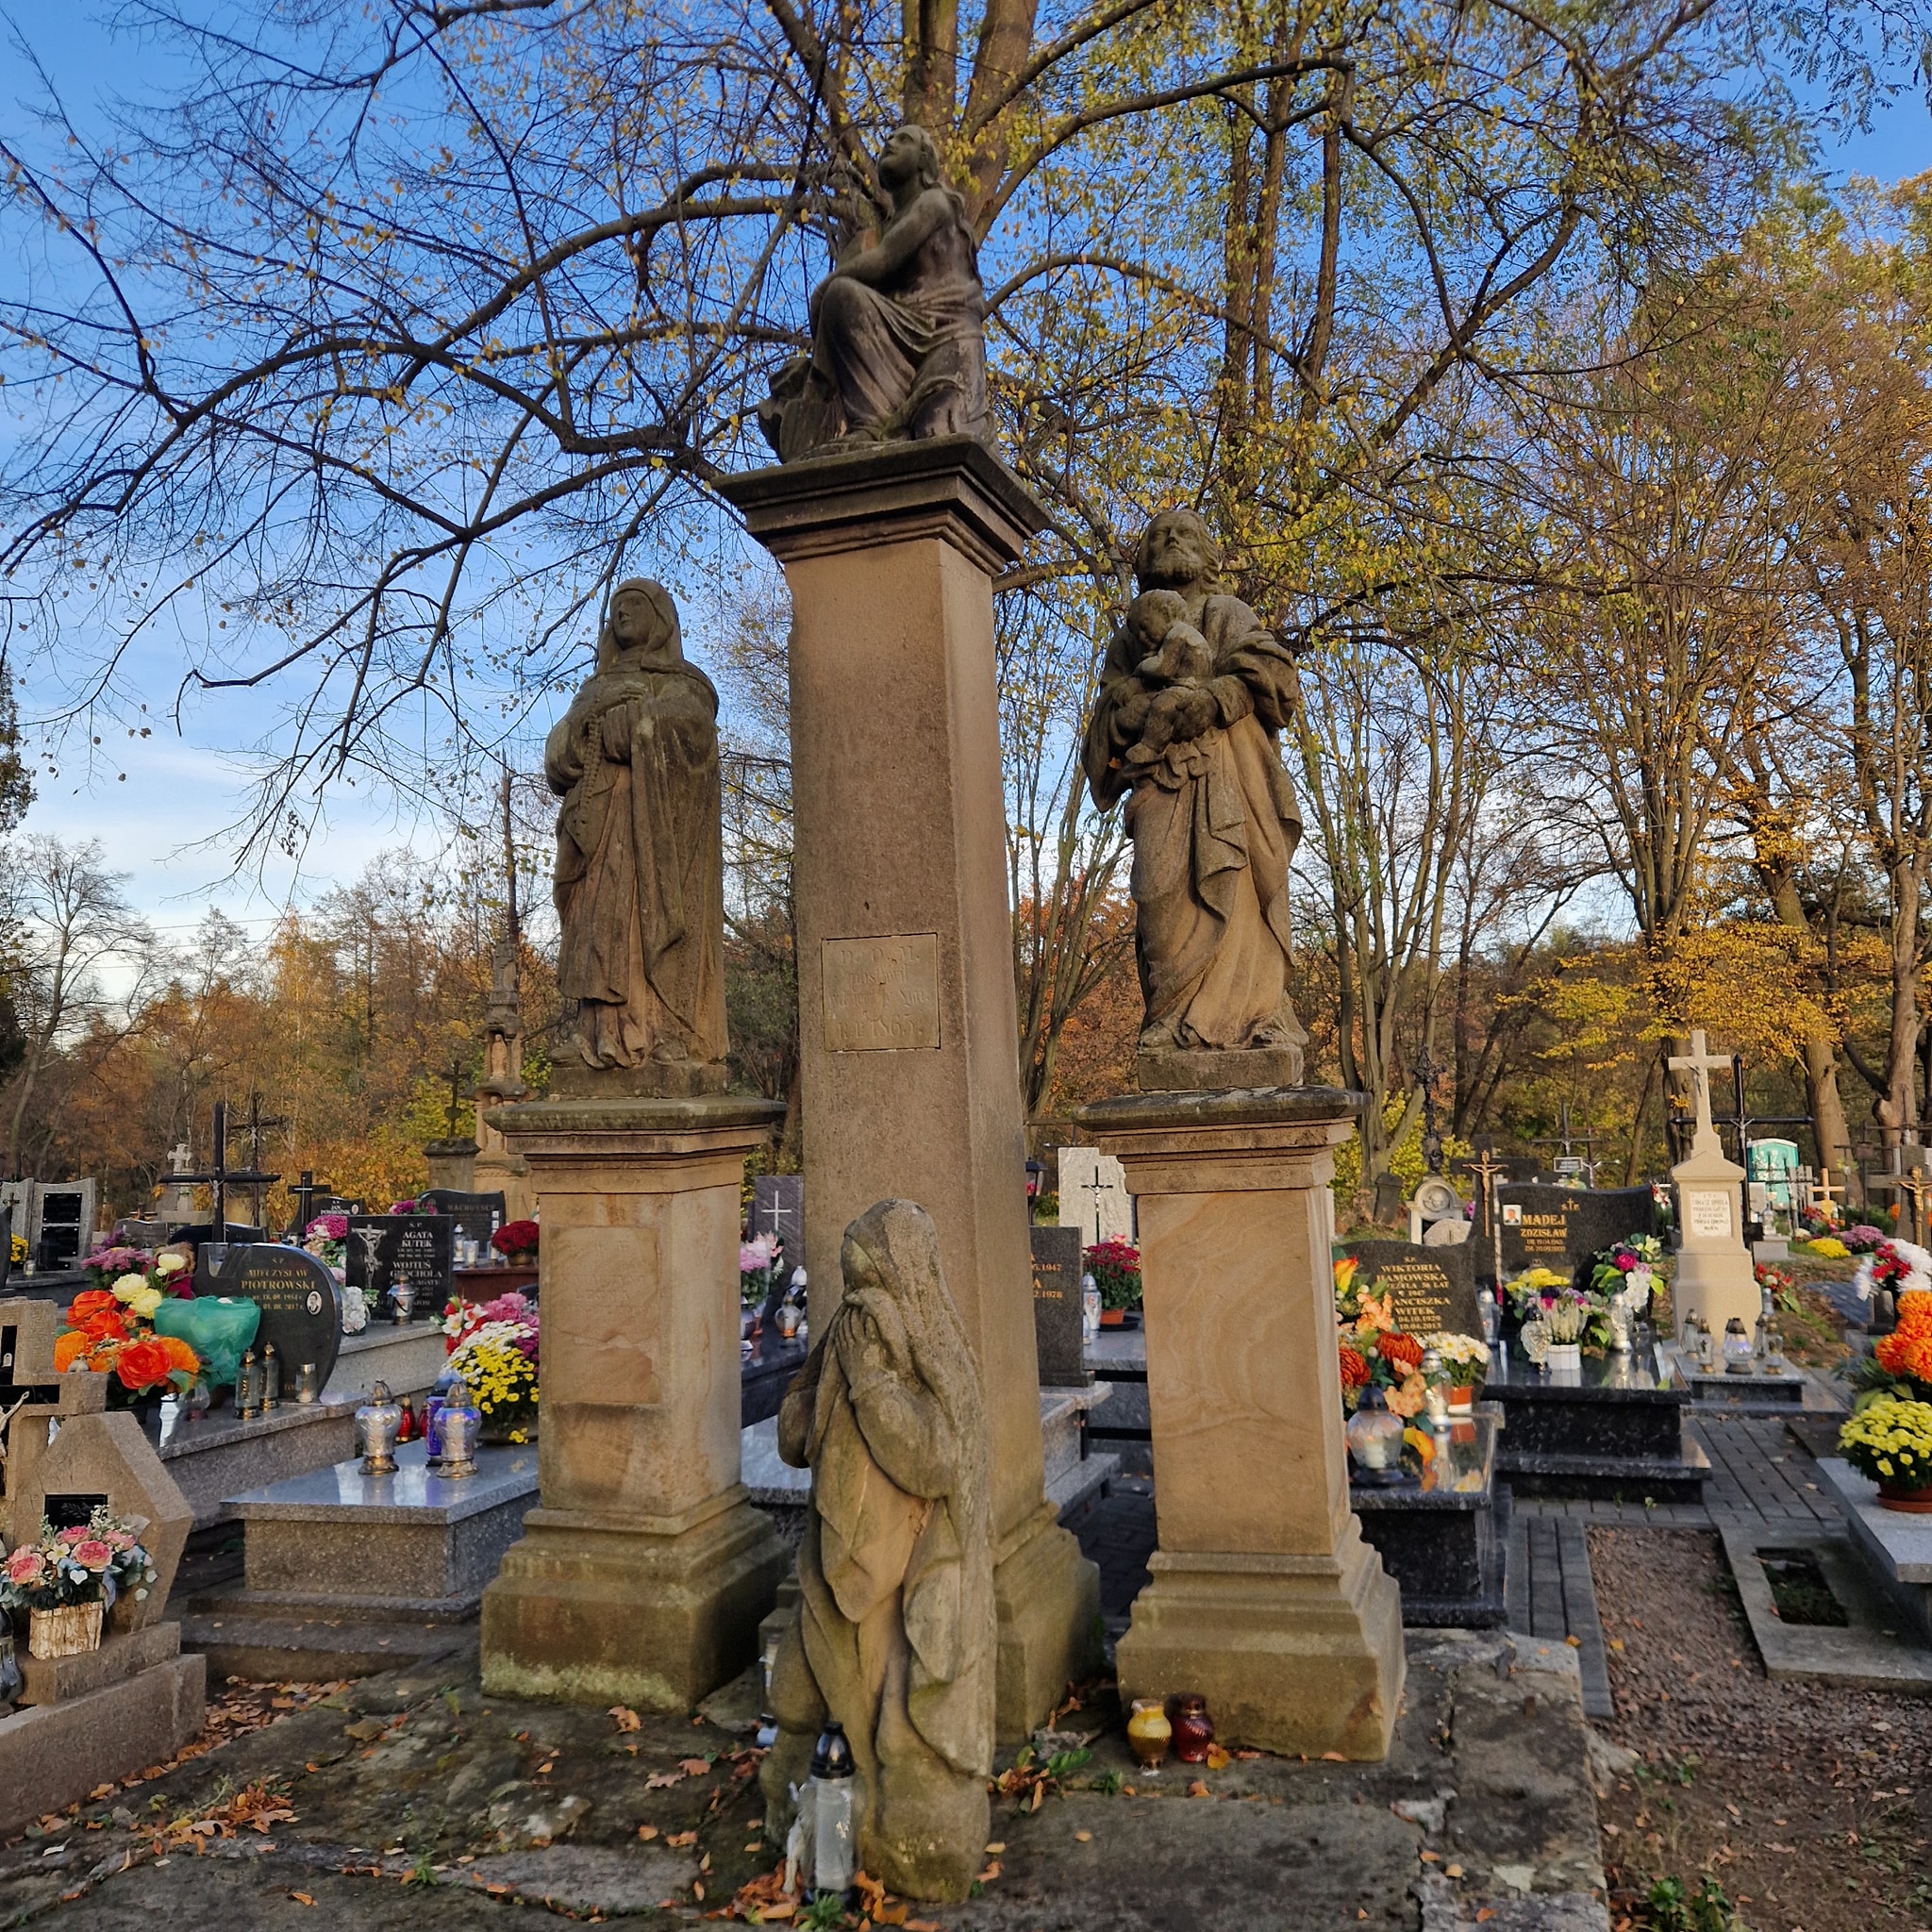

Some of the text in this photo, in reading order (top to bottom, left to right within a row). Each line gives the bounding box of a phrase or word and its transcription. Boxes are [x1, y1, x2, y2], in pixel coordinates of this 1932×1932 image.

[1522, 1214, 1566, 1225] MADEJ
[1520, 1228, 1568, 1238] ZDZISŁAW
[401, 1240, 432, 1248] KUTEK
[1380, 1264, 1441, 1273] WIKTORIA
[241, 1279, 316, 1290] PIOTROWSKI
[1393, 1297, 1452, 1306] ANCISZKA
[1394, 1307, 1435, 1315] WITEK
